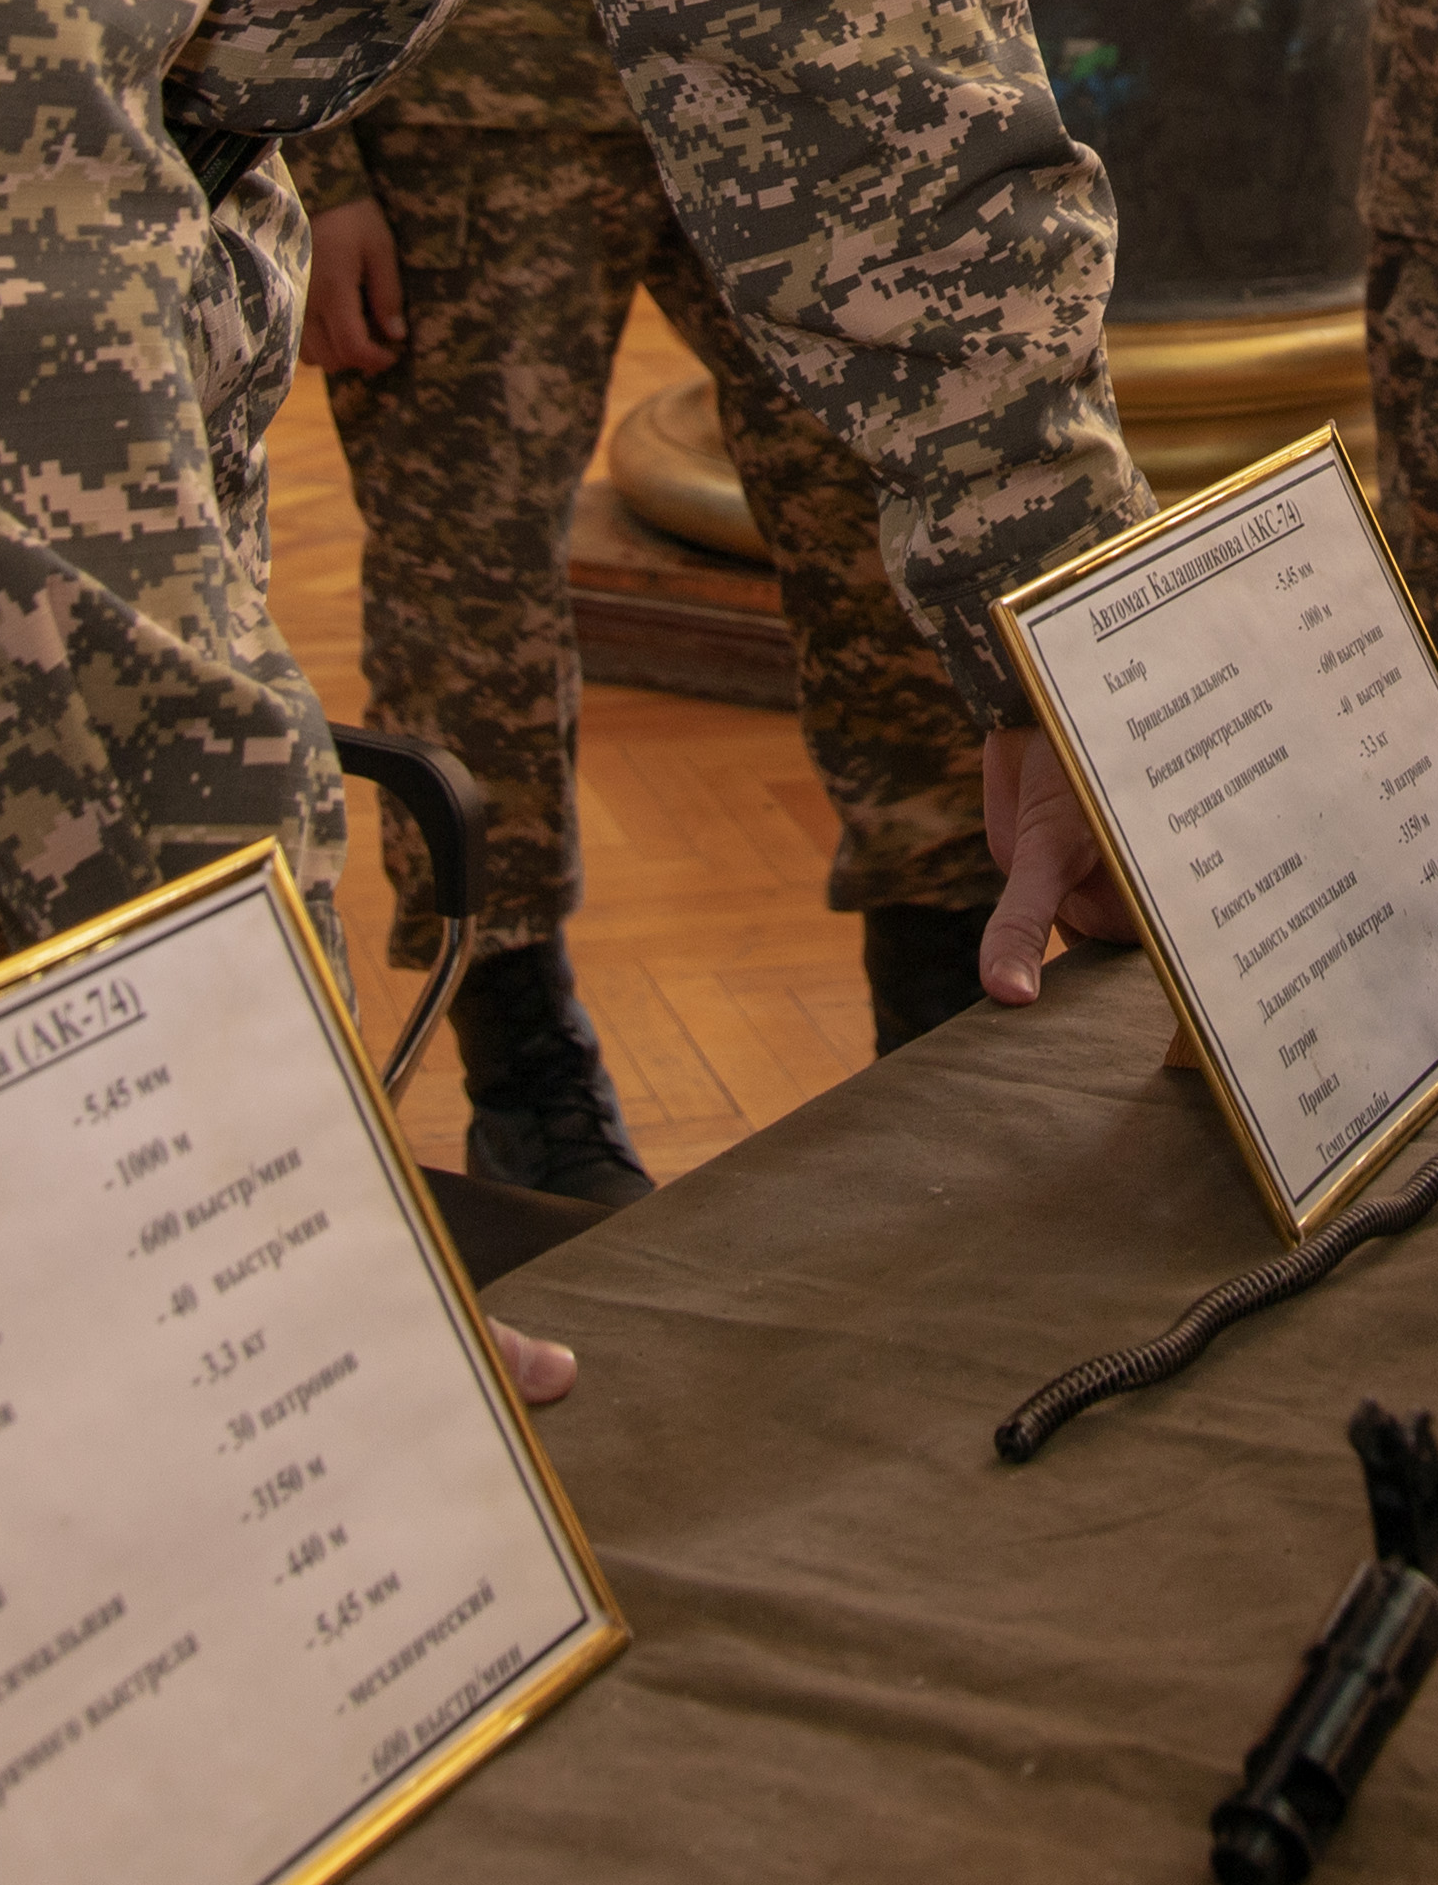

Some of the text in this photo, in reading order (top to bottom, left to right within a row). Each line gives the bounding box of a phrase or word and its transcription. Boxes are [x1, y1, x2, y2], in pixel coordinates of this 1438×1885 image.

[1089, 501, 1302, 635] Автомат Калашникова (АКС-74)
[1298, 562, 1314, 578] мм
[1322, 604, 1332, 618] м
[1336, 626, 1384, 664] выстр/мин
[1103, 659, 1147, 694] Калибр
[1356, 667, 1402, 706] выстр/мин
[1126, 662, 1239, 742] Прицельная дальность
[1145, 699, 1273, 789] Боевая скорострельность
[1376, 731, 1388, 748] кг
[1168, 745, 1289, 834] Очередная одиночными
[1394, 756, 1432, 792] патронов
[1421, 814, 1430, 827] м
[1189, 850, 1224, 882] Масса
[1211, 853, 1303, 929] Емкость магазина
[1233, 871, 1358, 979] Дальность максимальная
[1257, 902, 1394, 1026] Дальность прямого выстрела
[15, 982, 146, 1074] (АК-74)
[1278, 1028, 1318, 1069] Патрон
[135, 1065, 171, 1095] мм
[1298, 1073, 1340, 1116] Прицел
[172, 1133, 192, 1155] м
[1316, 1091, 1390, 1164] Темп стрельбы
[183, 1148, 302, 1230] выстр/мин
[212, 1210, 330, 1294] выстр/мин
[241, 1330, 266, 1360] кг
[259, 1352, 358, 1429] патронов
[306, 1456, 326, 1479] м
[328, 1525, 348, 1547] м
[366, 1572, 401, 1607] мм
[348, 1579, 496, 1707] механический
